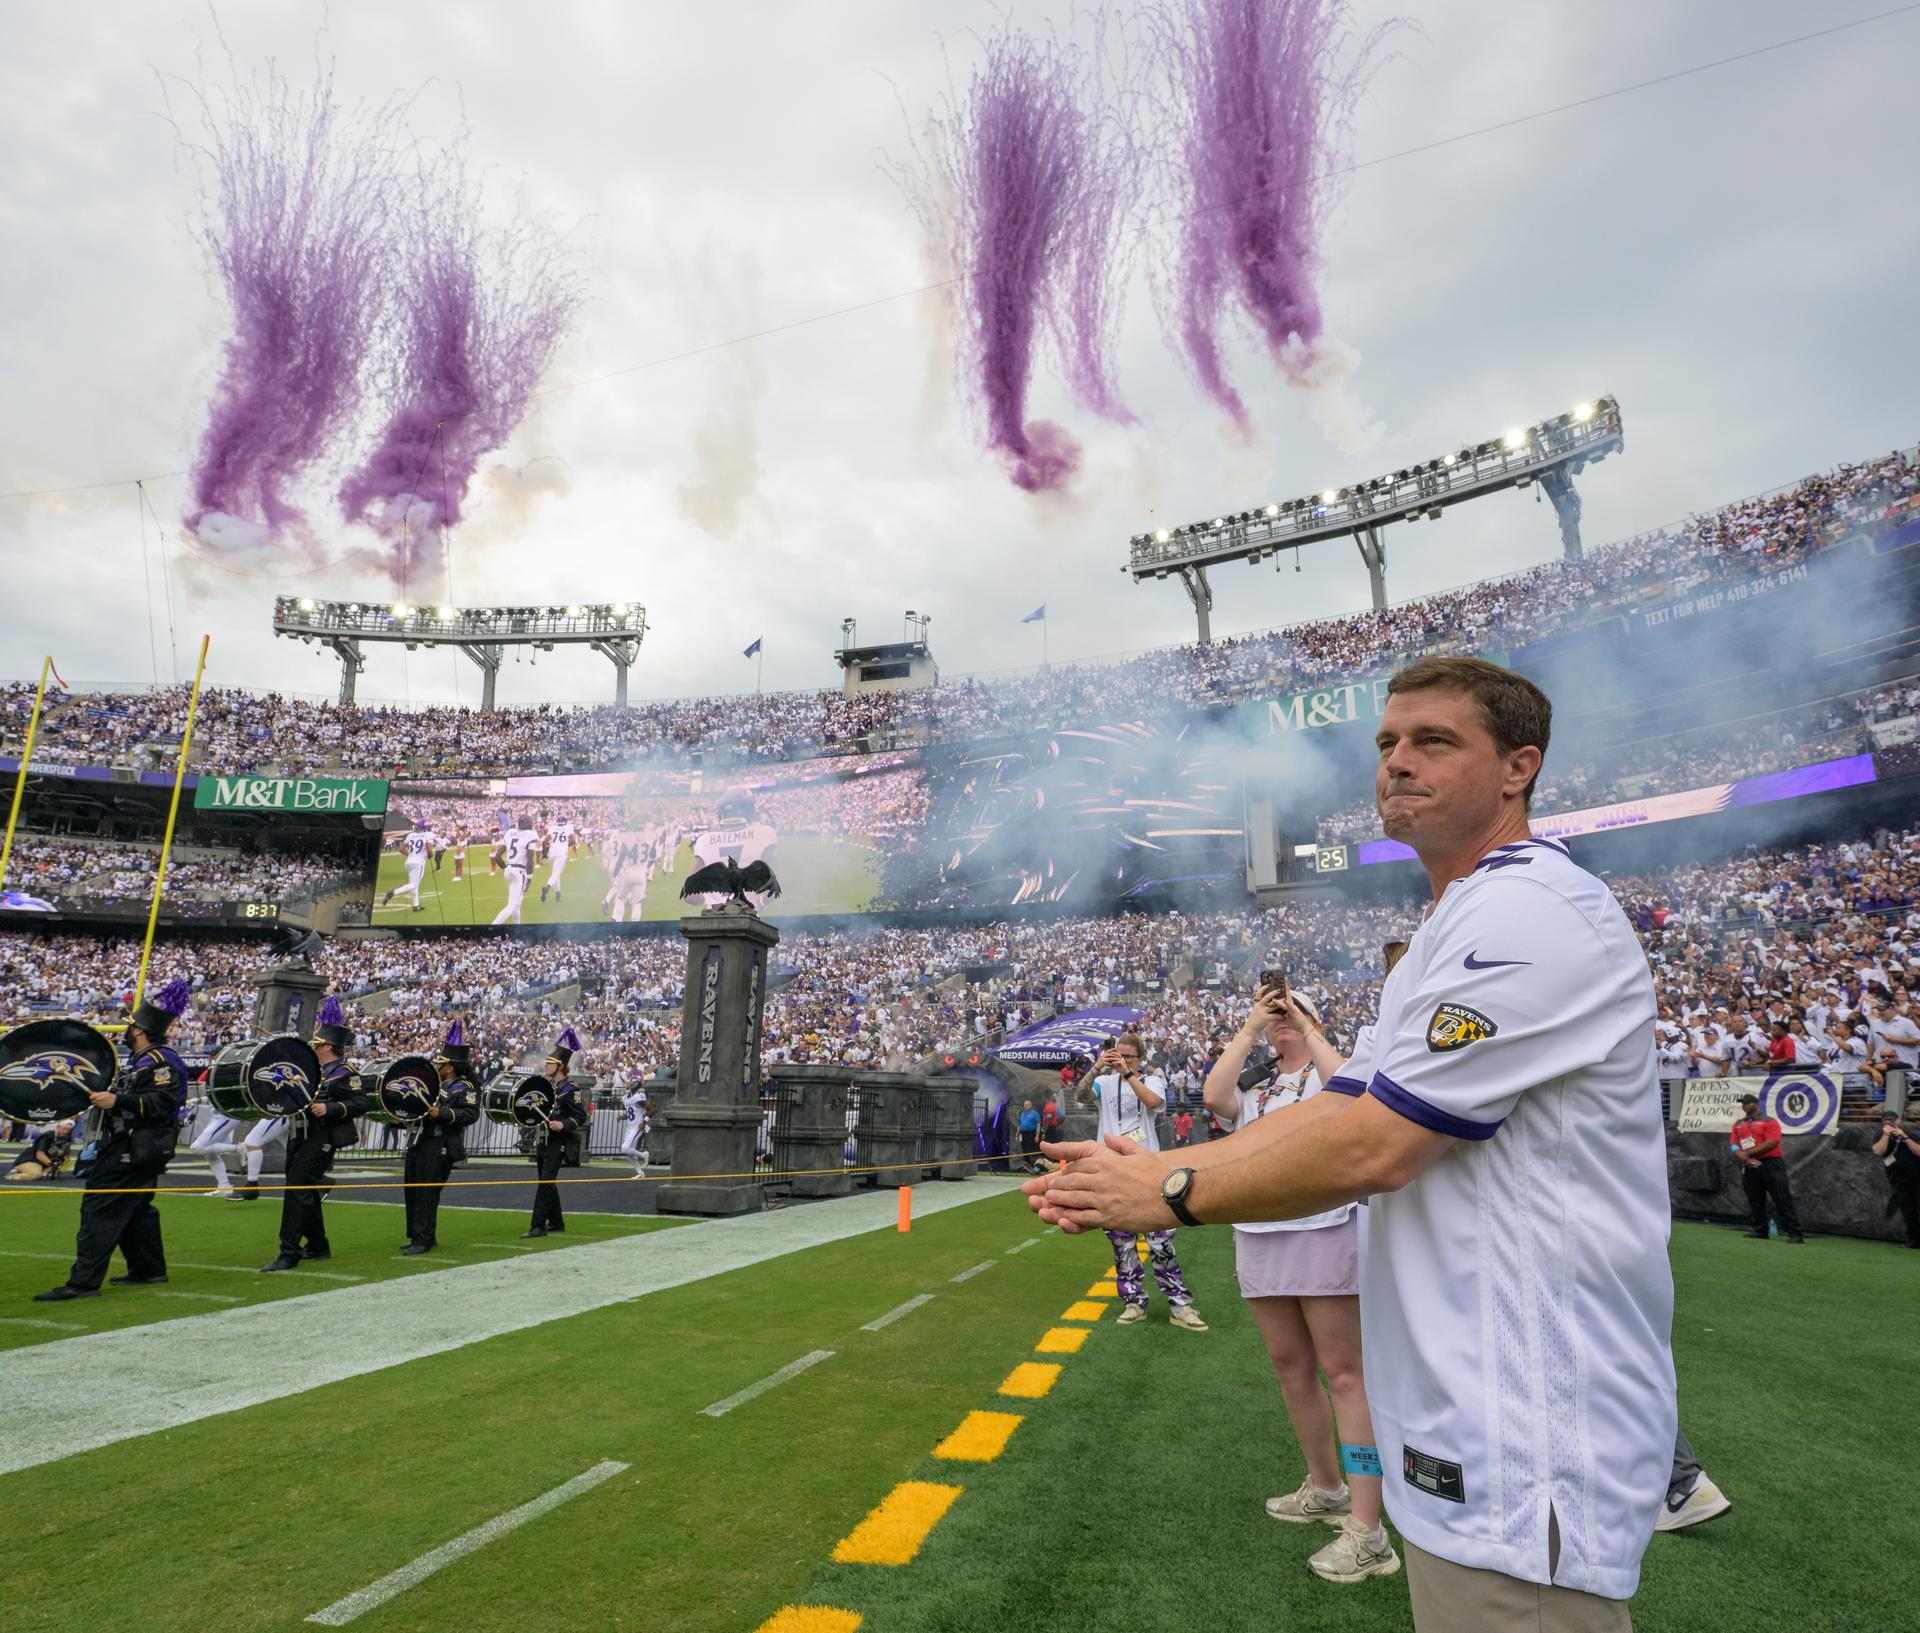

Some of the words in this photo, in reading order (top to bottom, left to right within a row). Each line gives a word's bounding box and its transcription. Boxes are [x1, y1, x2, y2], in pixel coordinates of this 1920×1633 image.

[1645, 609, 1669, 626] TEXT
[1673, 601, 1694, 618] FOR
[1696, 592, 1725, 612] HELP
[1727, 564, 1808, 602] 410-324-6141
[1265, 683, 1367, 736] M&T
[18, 761, 77, 777] #AVENSFLOCK
[212, 778, 294, 808] M&T
[294, 780, 369, 809] Bank
[1595, 804, 1649, 829] NOISE
[552, 831, 567, 844] 76
[710, 831, 754, 845] BATEMAN
[508, 837, 520, 860] 5
[1320, 849, 1343, 869] 25
[246, 903, 277, 918] 8:37
[699, 960, 719, 1083] RAVENS
[1442, 1005, 1492, 1032] RAVENS
[1000, 1051, 1038, 1060] MEDSTAR
[1039, 1052, 1071, 1061] HEALTH
[1689, 1080, 1731, 1092] RAVEN'S
[1687, 1093, 1745, 1104] TOUCHDOW
[1685, 1106, 1734, 1117] LANDING
[1682, 1119, 1703, 1129] PAD
[1351, 1451, 1373, 1461] WEEK
